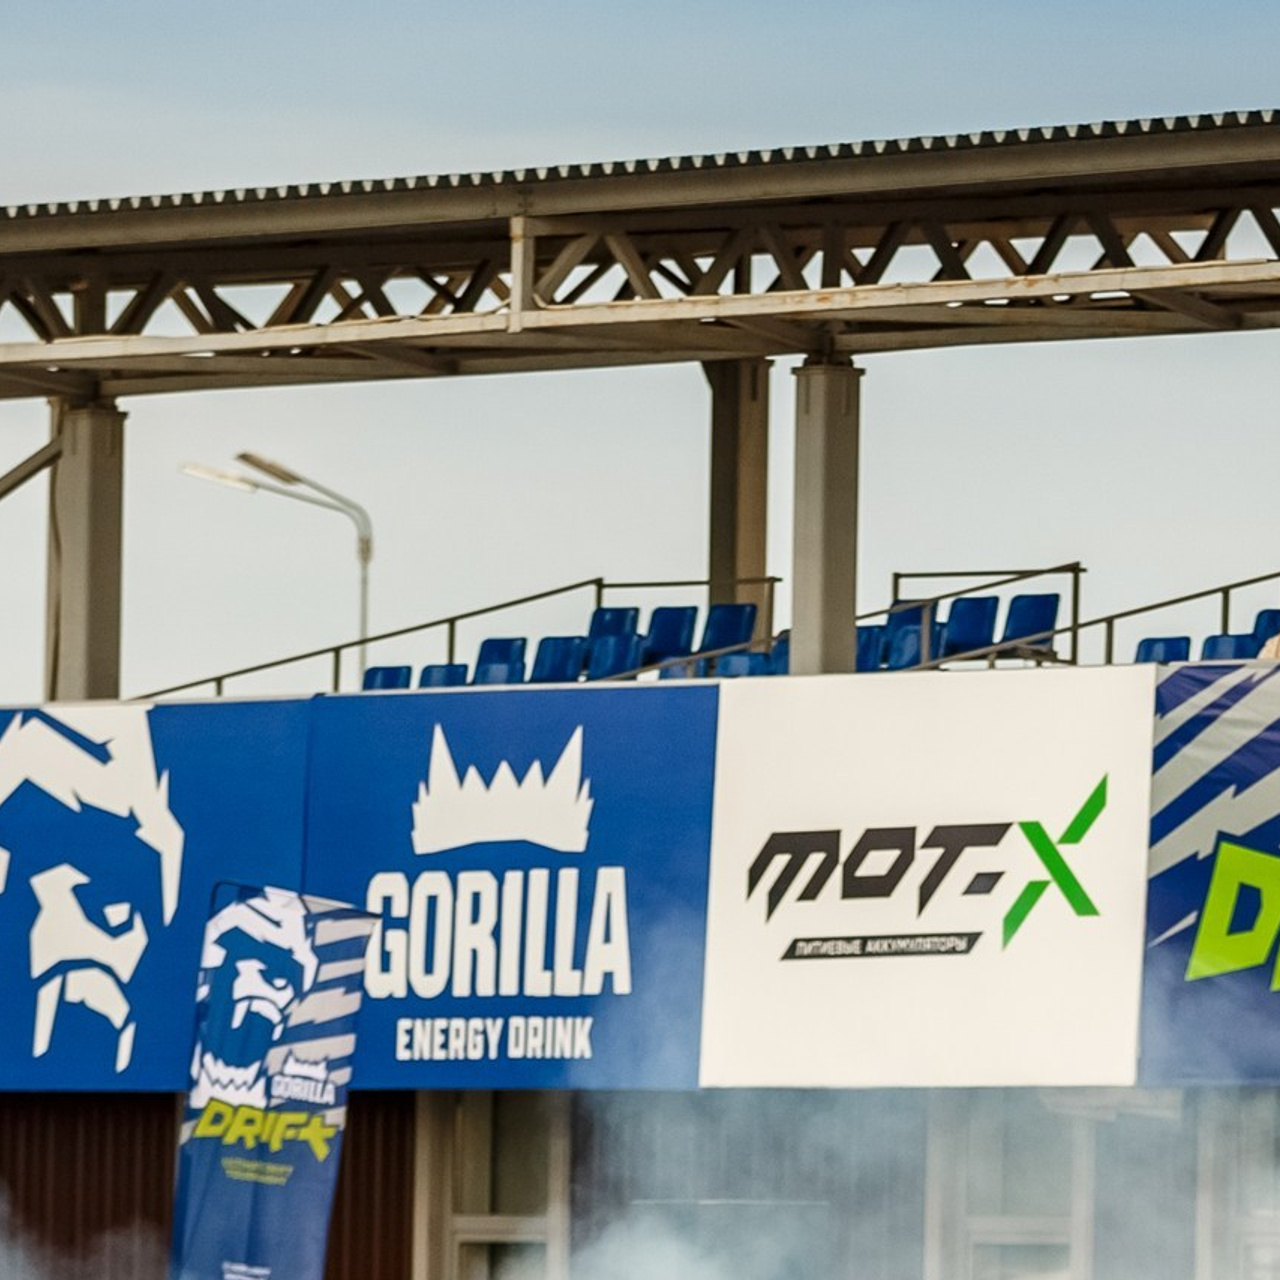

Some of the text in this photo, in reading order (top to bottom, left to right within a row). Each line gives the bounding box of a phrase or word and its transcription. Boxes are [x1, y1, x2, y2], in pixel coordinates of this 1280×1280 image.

[364, 866, 632, 999] GORILLA
[396, 1016, 593, 1061] ENERGY DRINK
[193, 1098, 339, 1162] DRIFT
